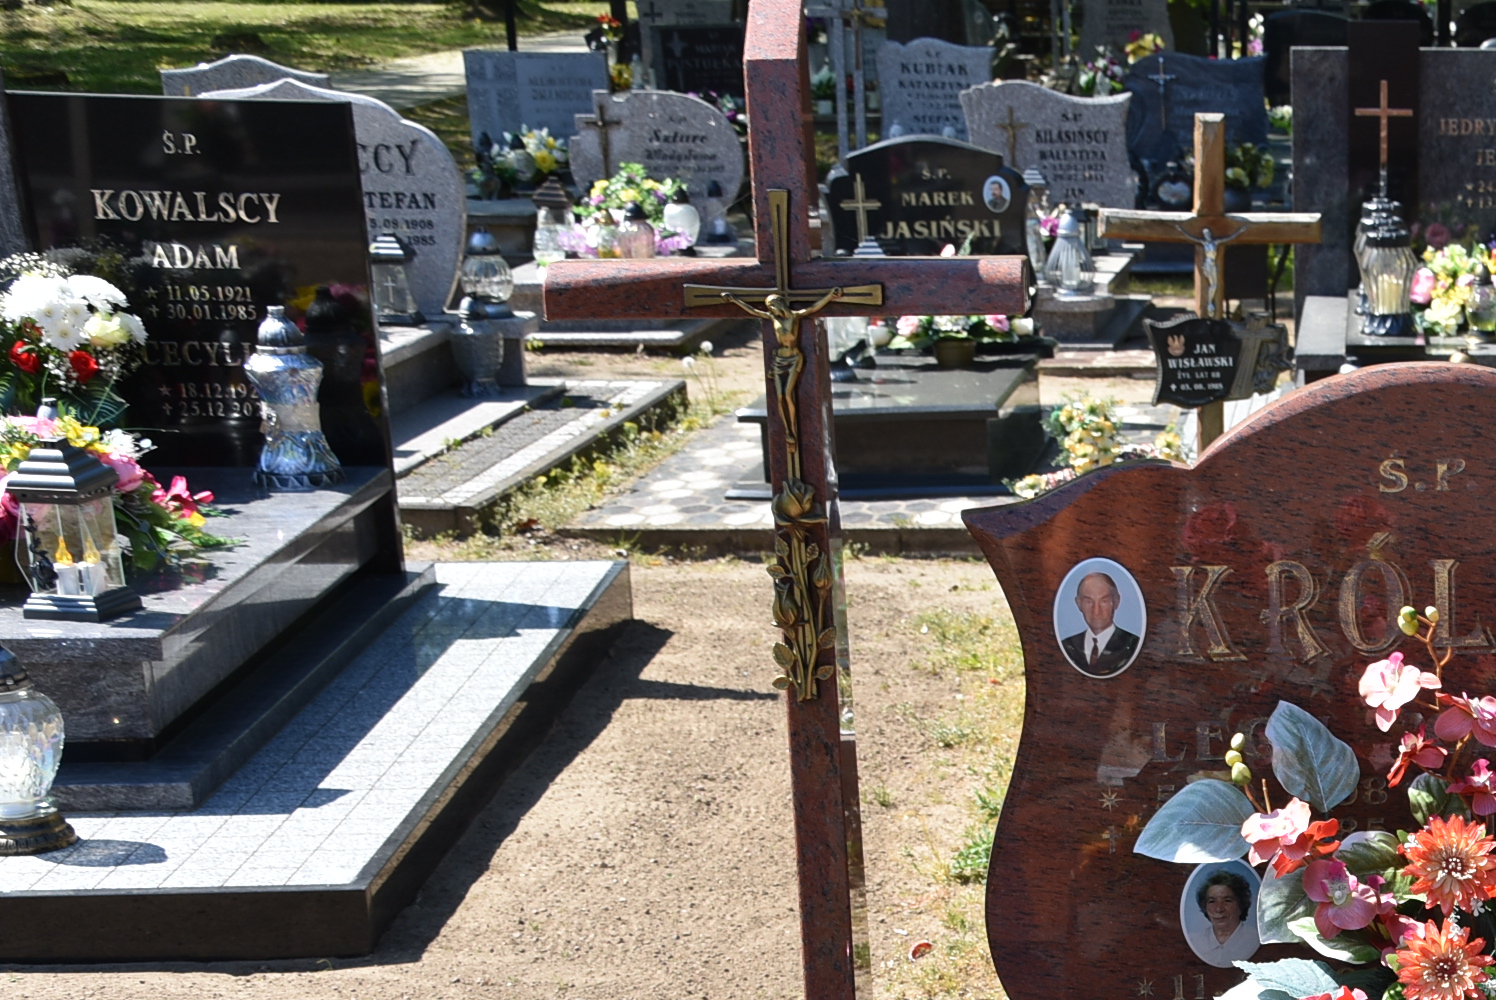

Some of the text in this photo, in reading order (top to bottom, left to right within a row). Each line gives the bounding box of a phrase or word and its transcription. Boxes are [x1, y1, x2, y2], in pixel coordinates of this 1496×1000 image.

[90, 188, 281, 223] KOWALSCY
[364, 191, 436, 210] TEFAN
[902, 191, 975, 207] MAREK
[880, 215, 1001, 239] JASIŃSKI
[152, 243, 242, 270] ADAM
[167, 285, 253, 301] 11.05.1921
[167, 304, 257, 321] 30.01.1985
[1193, 344, 1216, 354] JAN
[180, 382, 259, 399] 18.12.192
